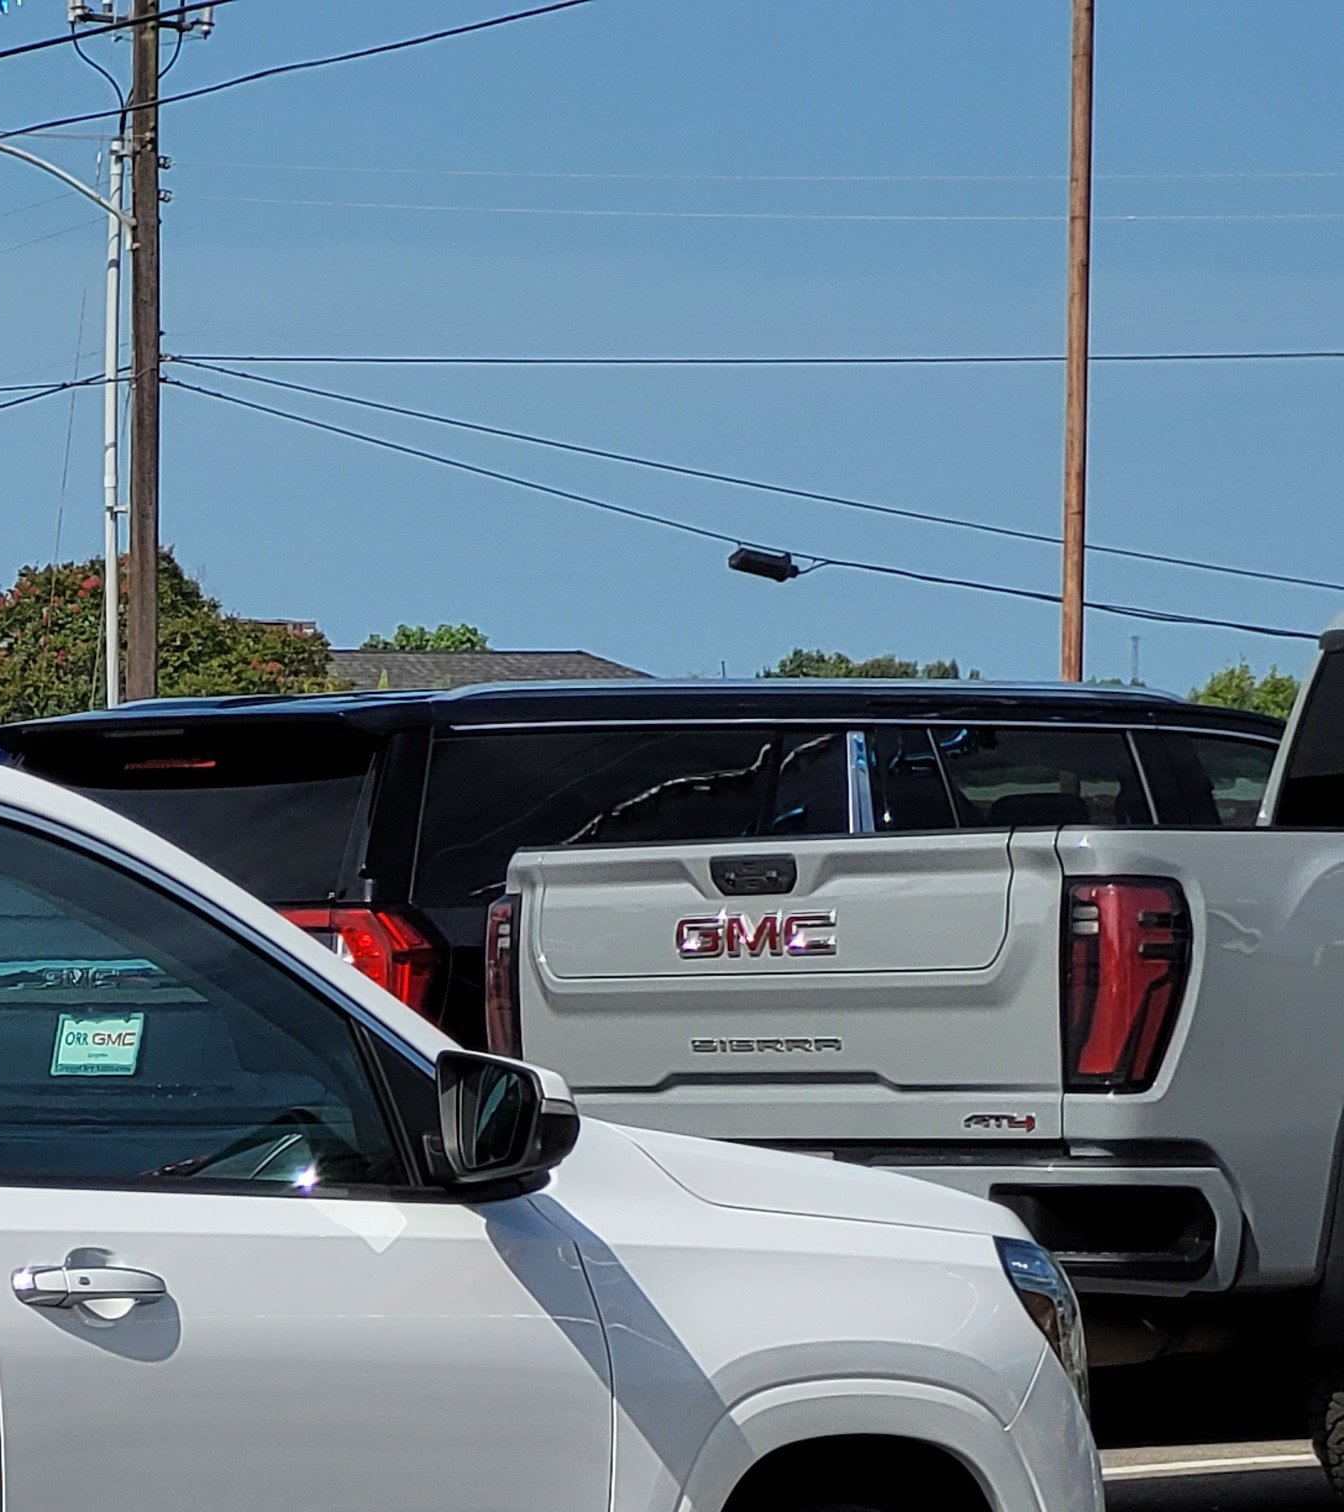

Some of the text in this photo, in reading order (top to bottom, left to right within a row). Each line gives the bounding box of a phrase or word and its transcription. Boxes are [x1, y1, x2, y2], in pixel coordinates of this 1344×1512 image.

[675, 907, 837, 959] GMC
[65, 1031, 136, 1048] ORR GMC
[691, 1037, 843, 1053] SIERRA
